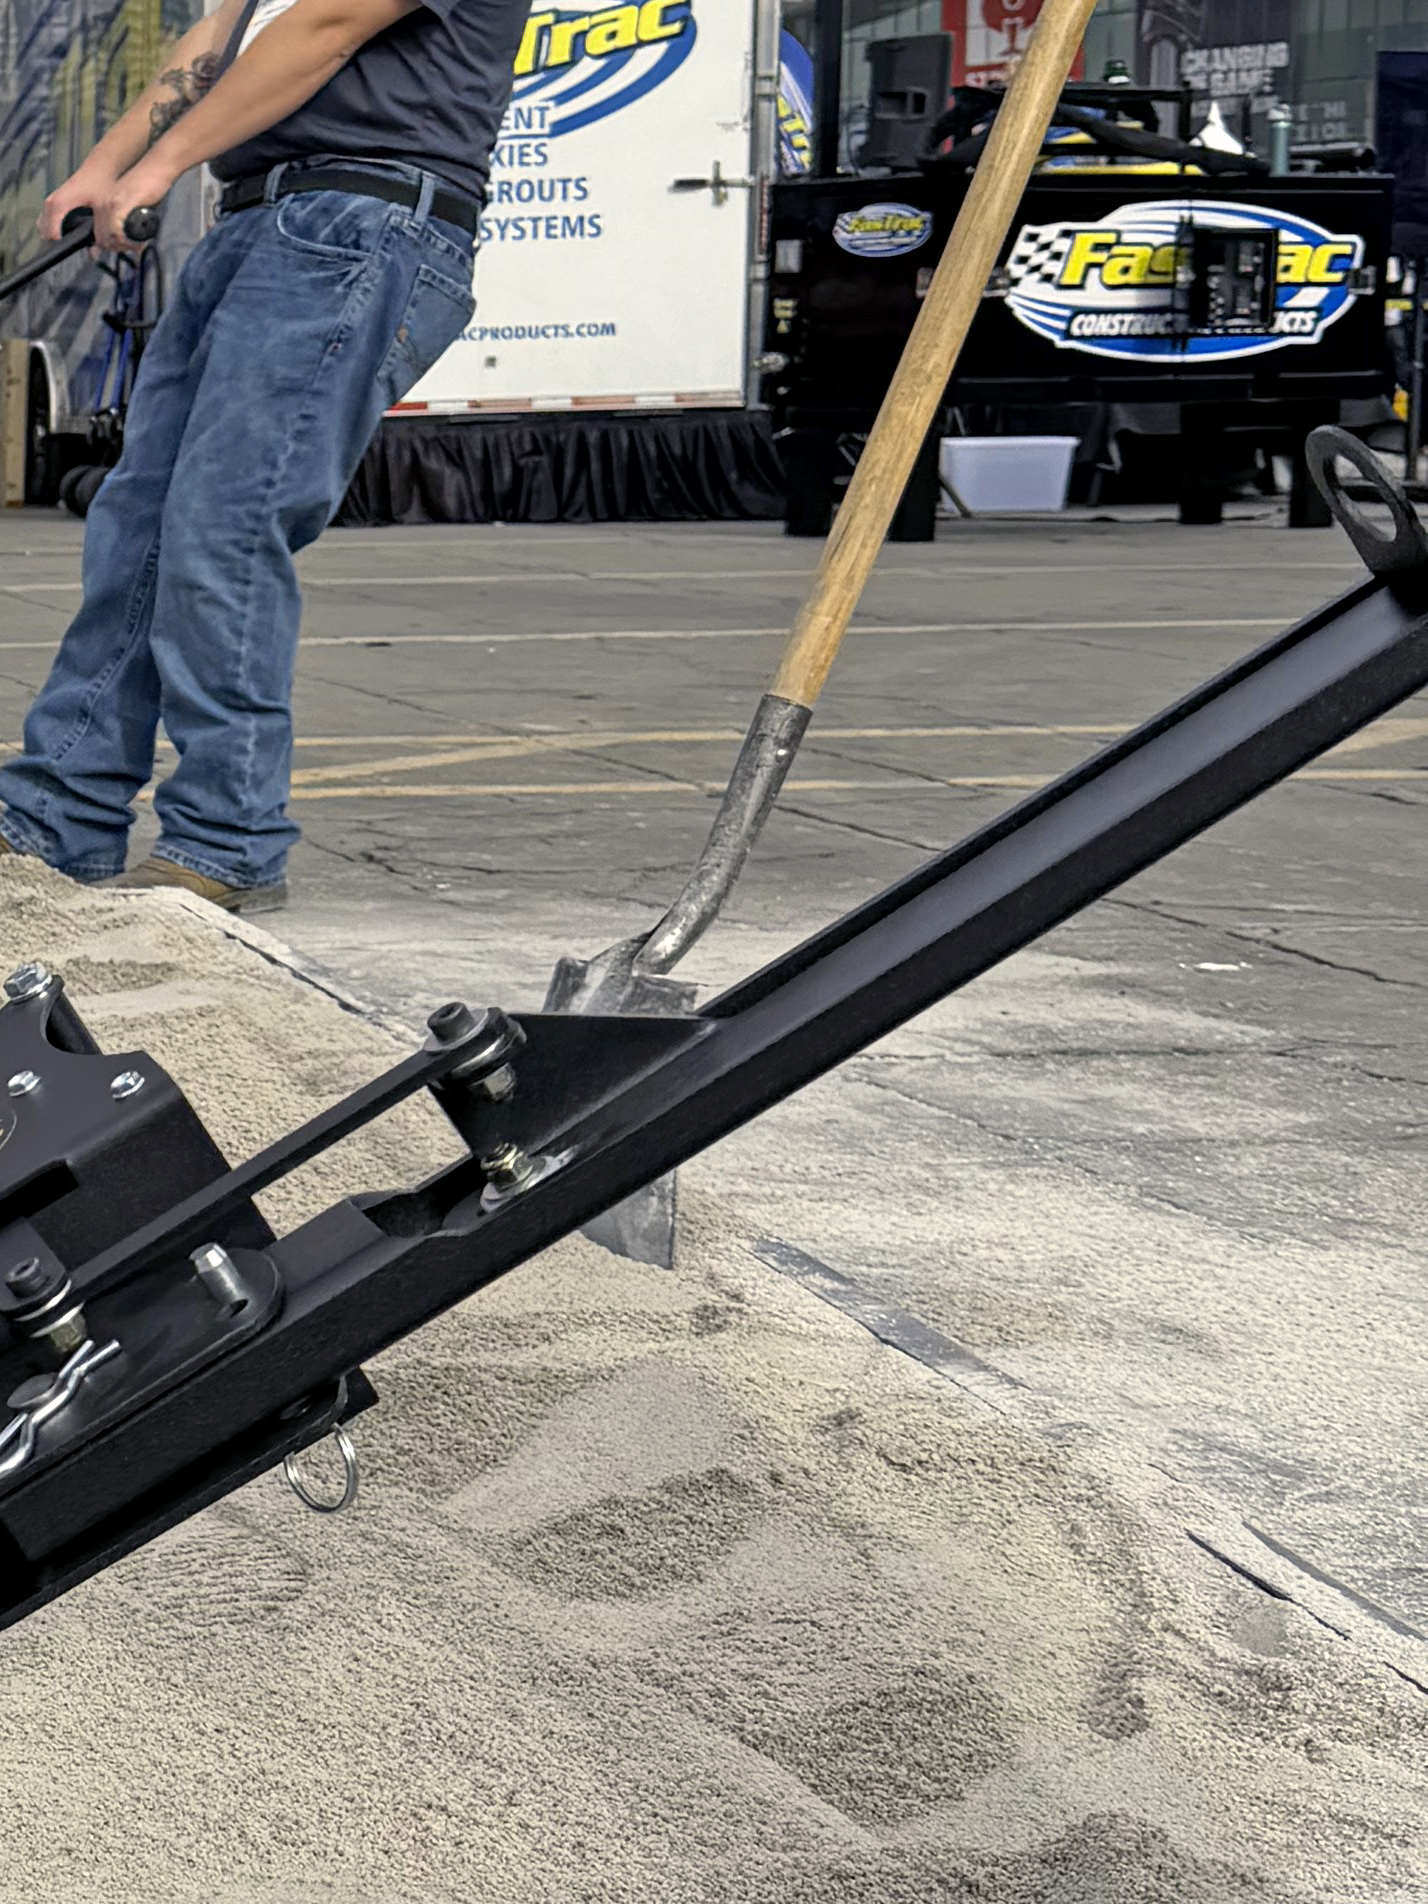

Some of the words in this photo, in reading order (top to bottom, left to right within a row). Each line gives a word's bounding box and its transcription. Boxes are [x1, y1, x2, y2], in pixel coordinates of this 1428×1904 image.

[490, 143, 548, 167] XIES
[480, 214, 602, 241] SYSTEMS
[1059, 231, 1354, 285] Fasac
[457, 322, 617, 341] ACPRODUCTS.COM
